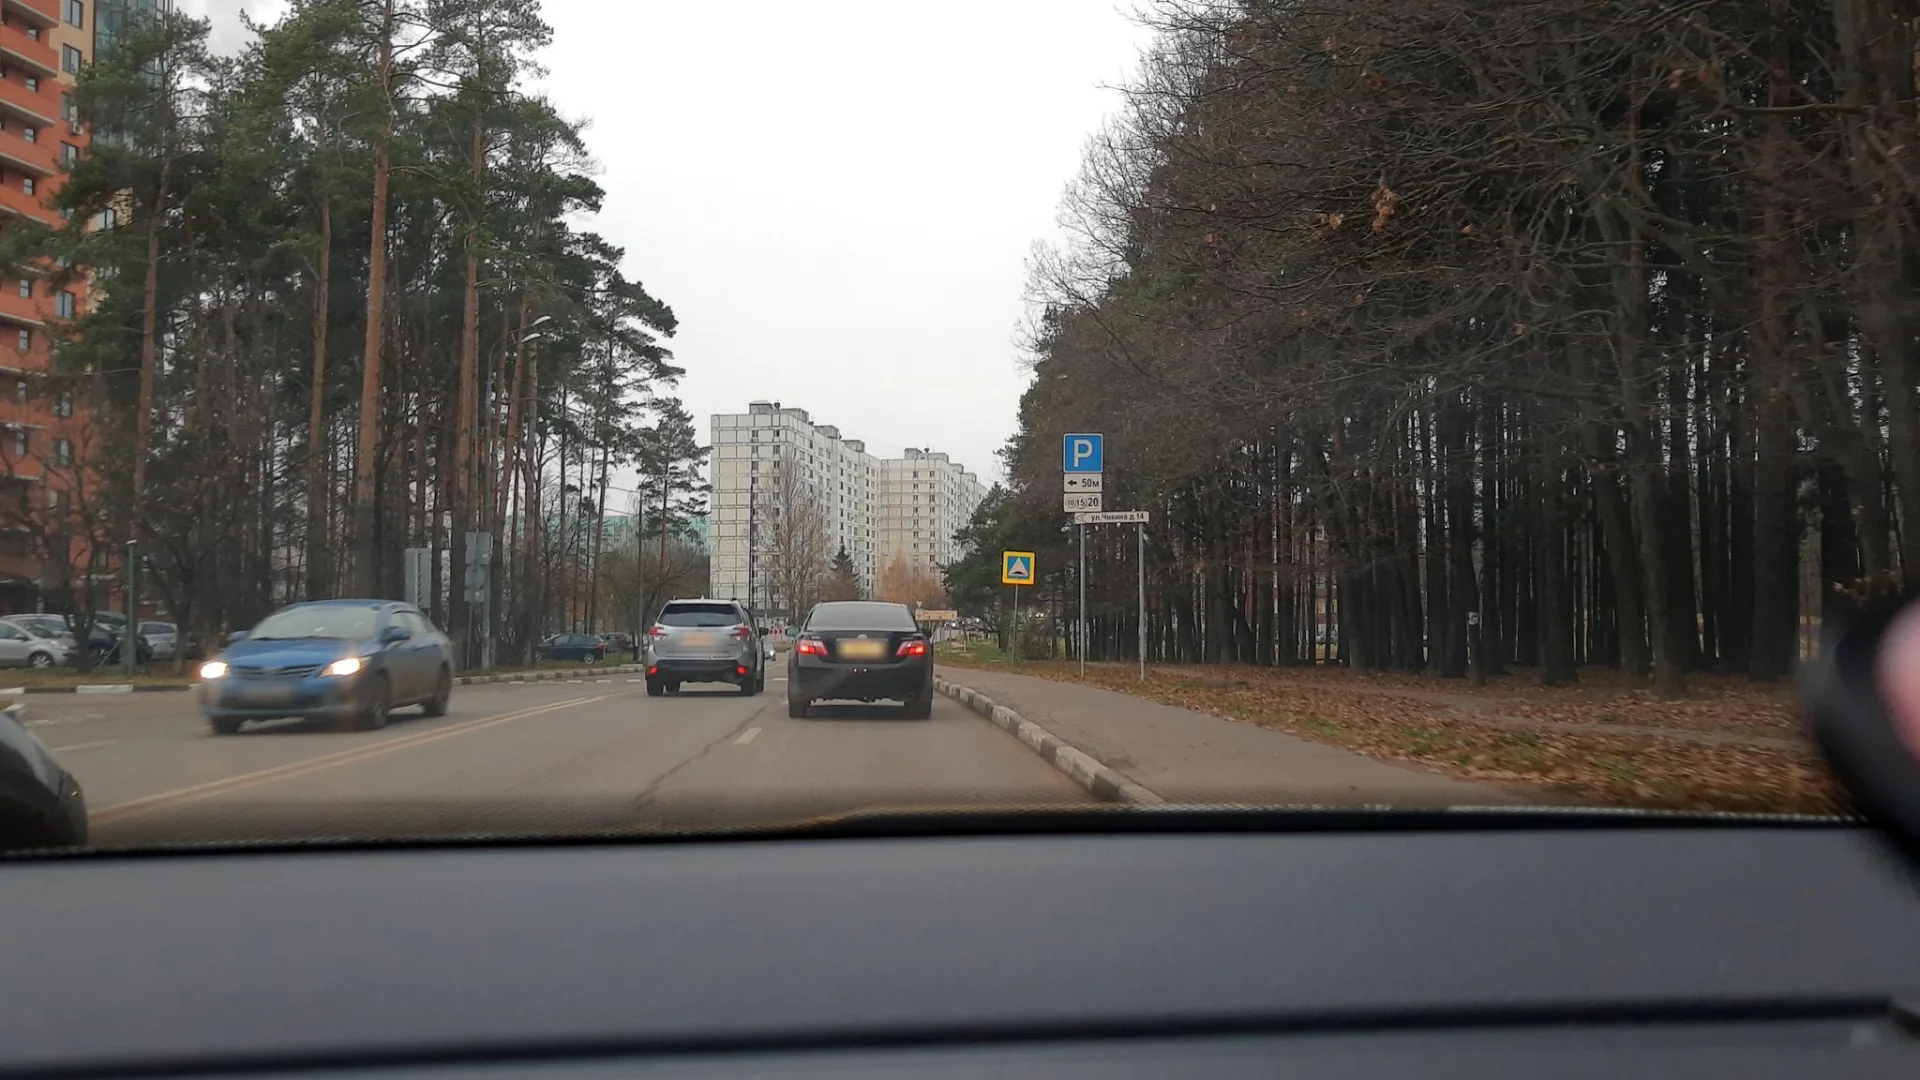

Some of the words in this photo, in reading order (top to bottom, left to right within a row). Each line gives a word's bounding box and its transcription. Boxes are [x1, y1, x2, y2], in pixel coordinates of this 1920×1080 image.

[1073, 439, 1093, 468] P
[1076, 498, 1085, 506] 15
[1087, 497, 1099, 507] 20
